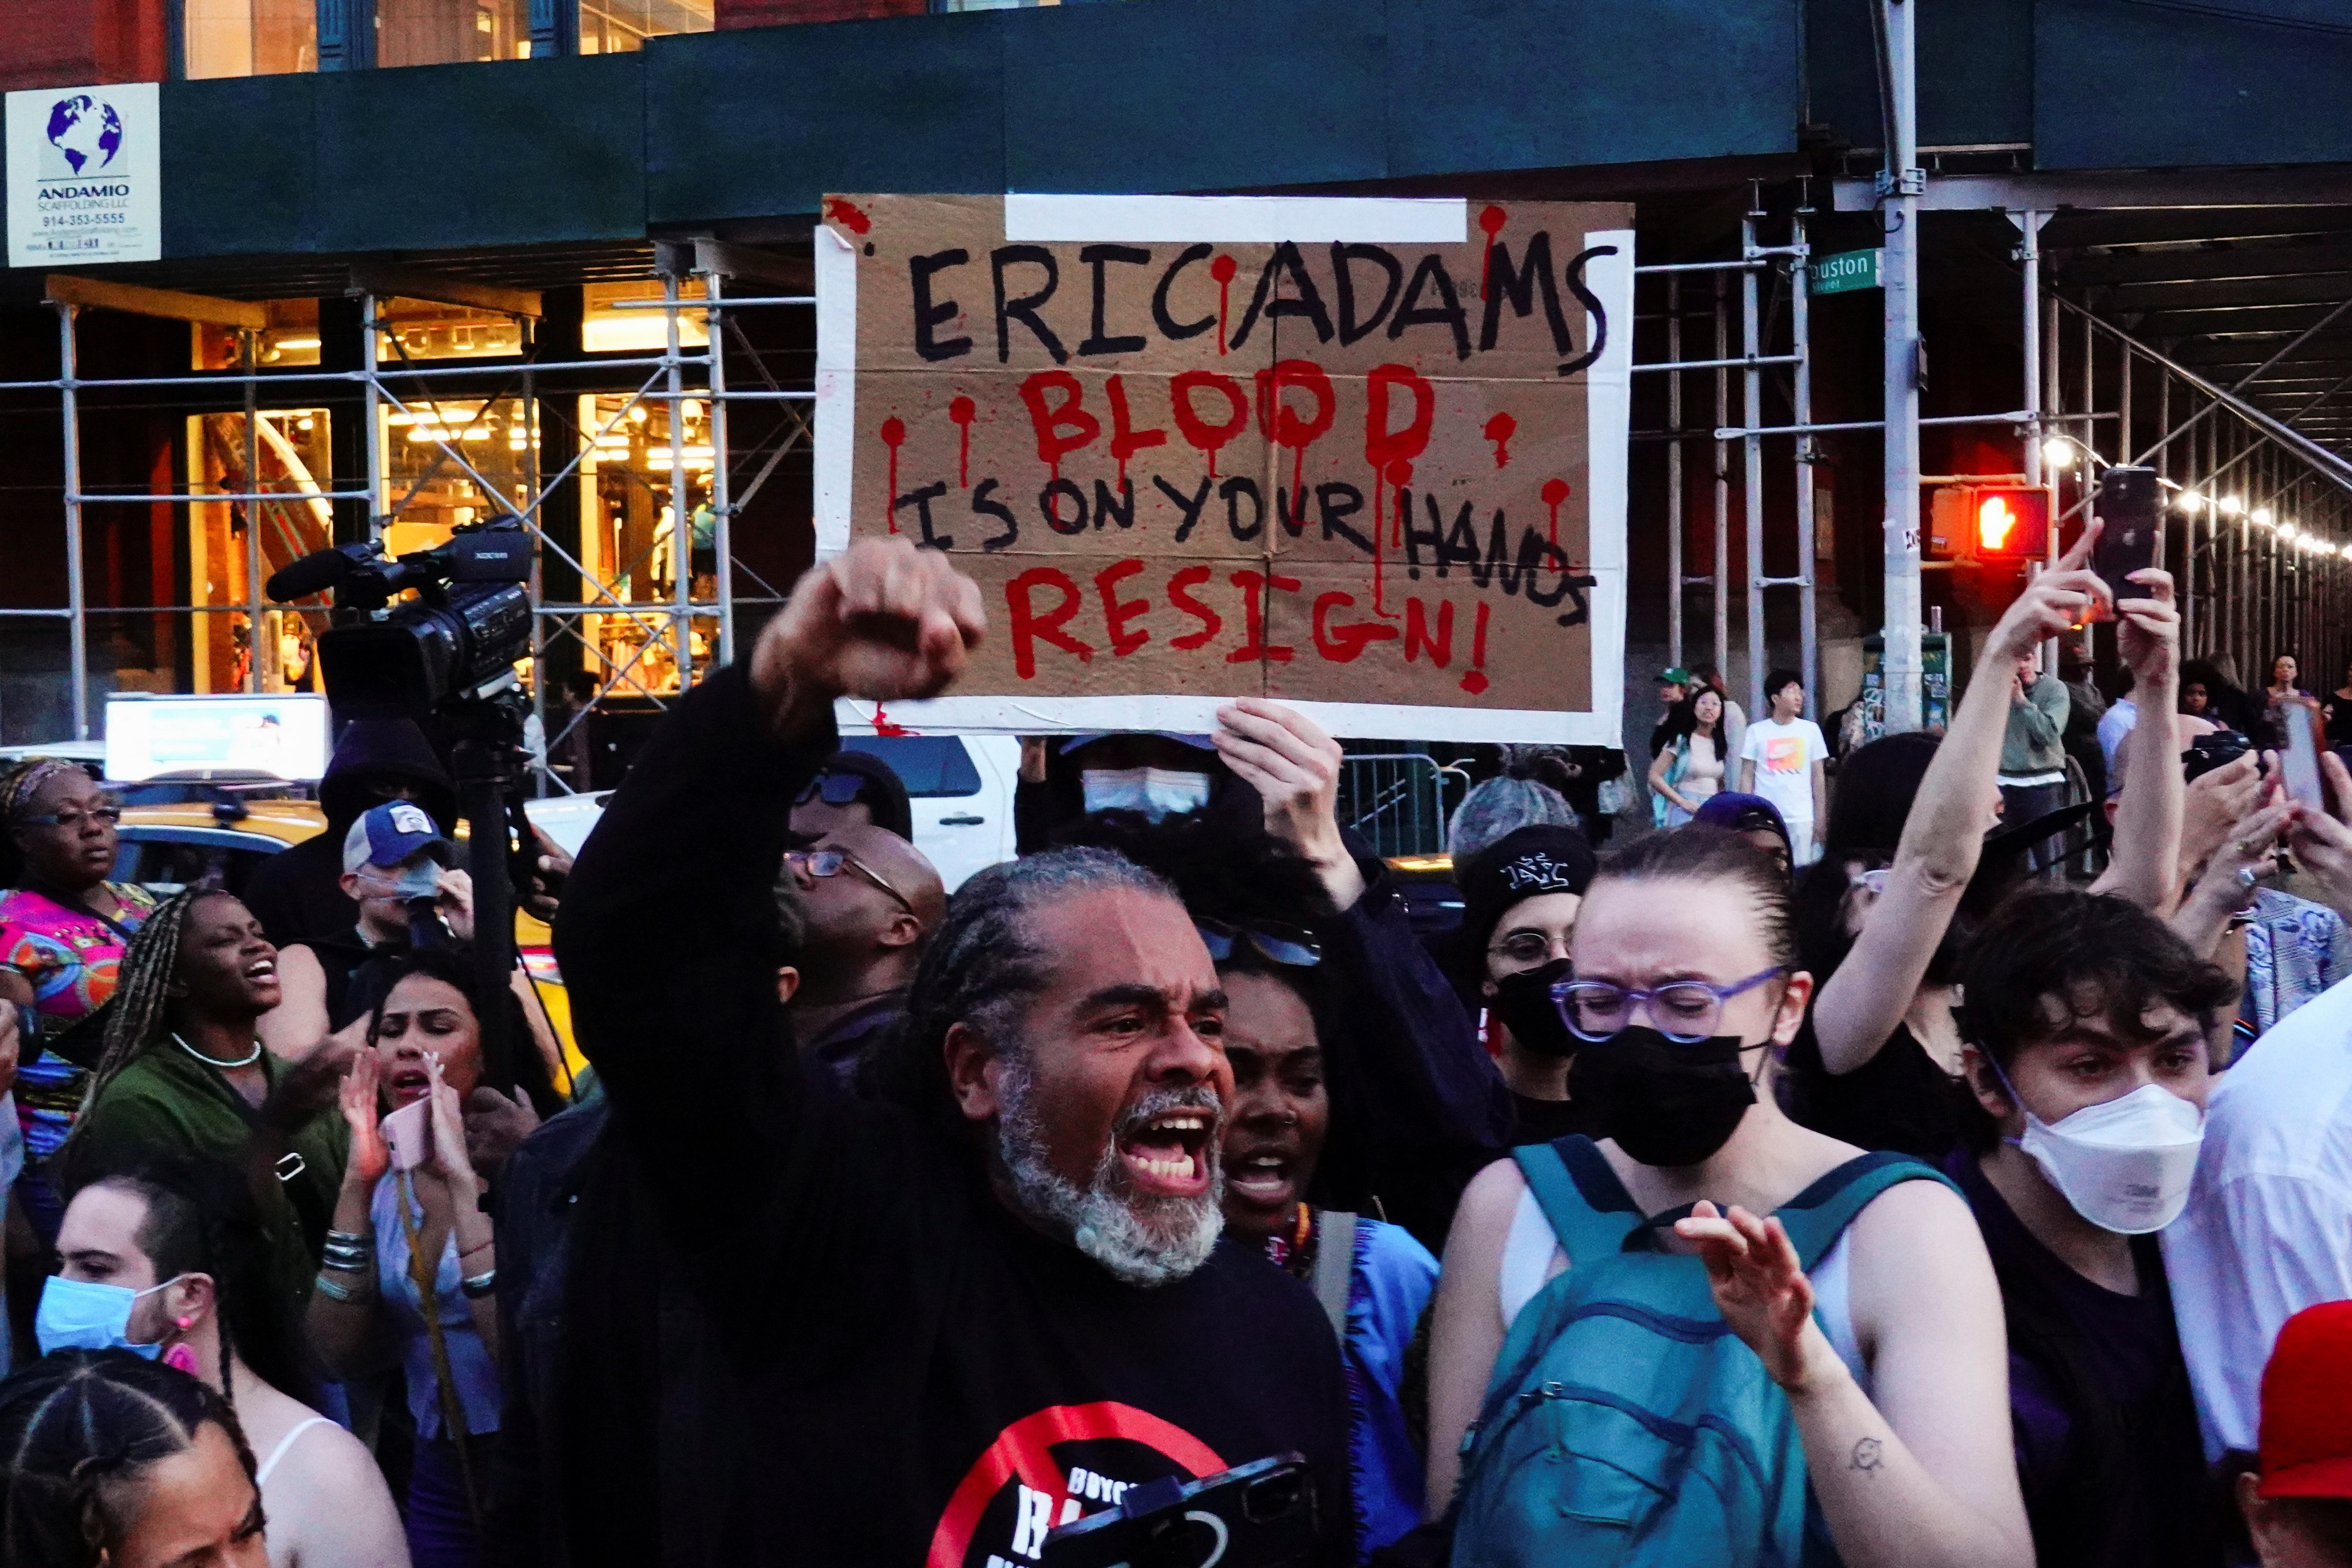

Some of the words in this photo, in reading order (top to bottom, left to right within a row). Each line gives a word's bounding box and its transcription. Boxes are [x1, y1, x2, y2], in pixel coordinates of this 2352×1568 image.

[38, 184, 130, 200] ANDAMIO
[38, 199, 109, 212] SCAFFOLDING
[111, 198, 129, 209] LLC
[43, 213, 125, 227] 914-353-5555
[1809, 257, 1868, 280] ouston
[909, 243, 1217, 364] ERIC
[1229, 231, 1618, 377] ADAMS
[1018, 359, 1434, 466] BLOOD
[895, 477, 1018, 551] IS
[1039, 477, 1134, 535] ON
[1152, 475, 1376, 554] YOUR
[1403, 487, 1597, 627] HANDS
[1005, 559, 1490, 695] RESIGN!
